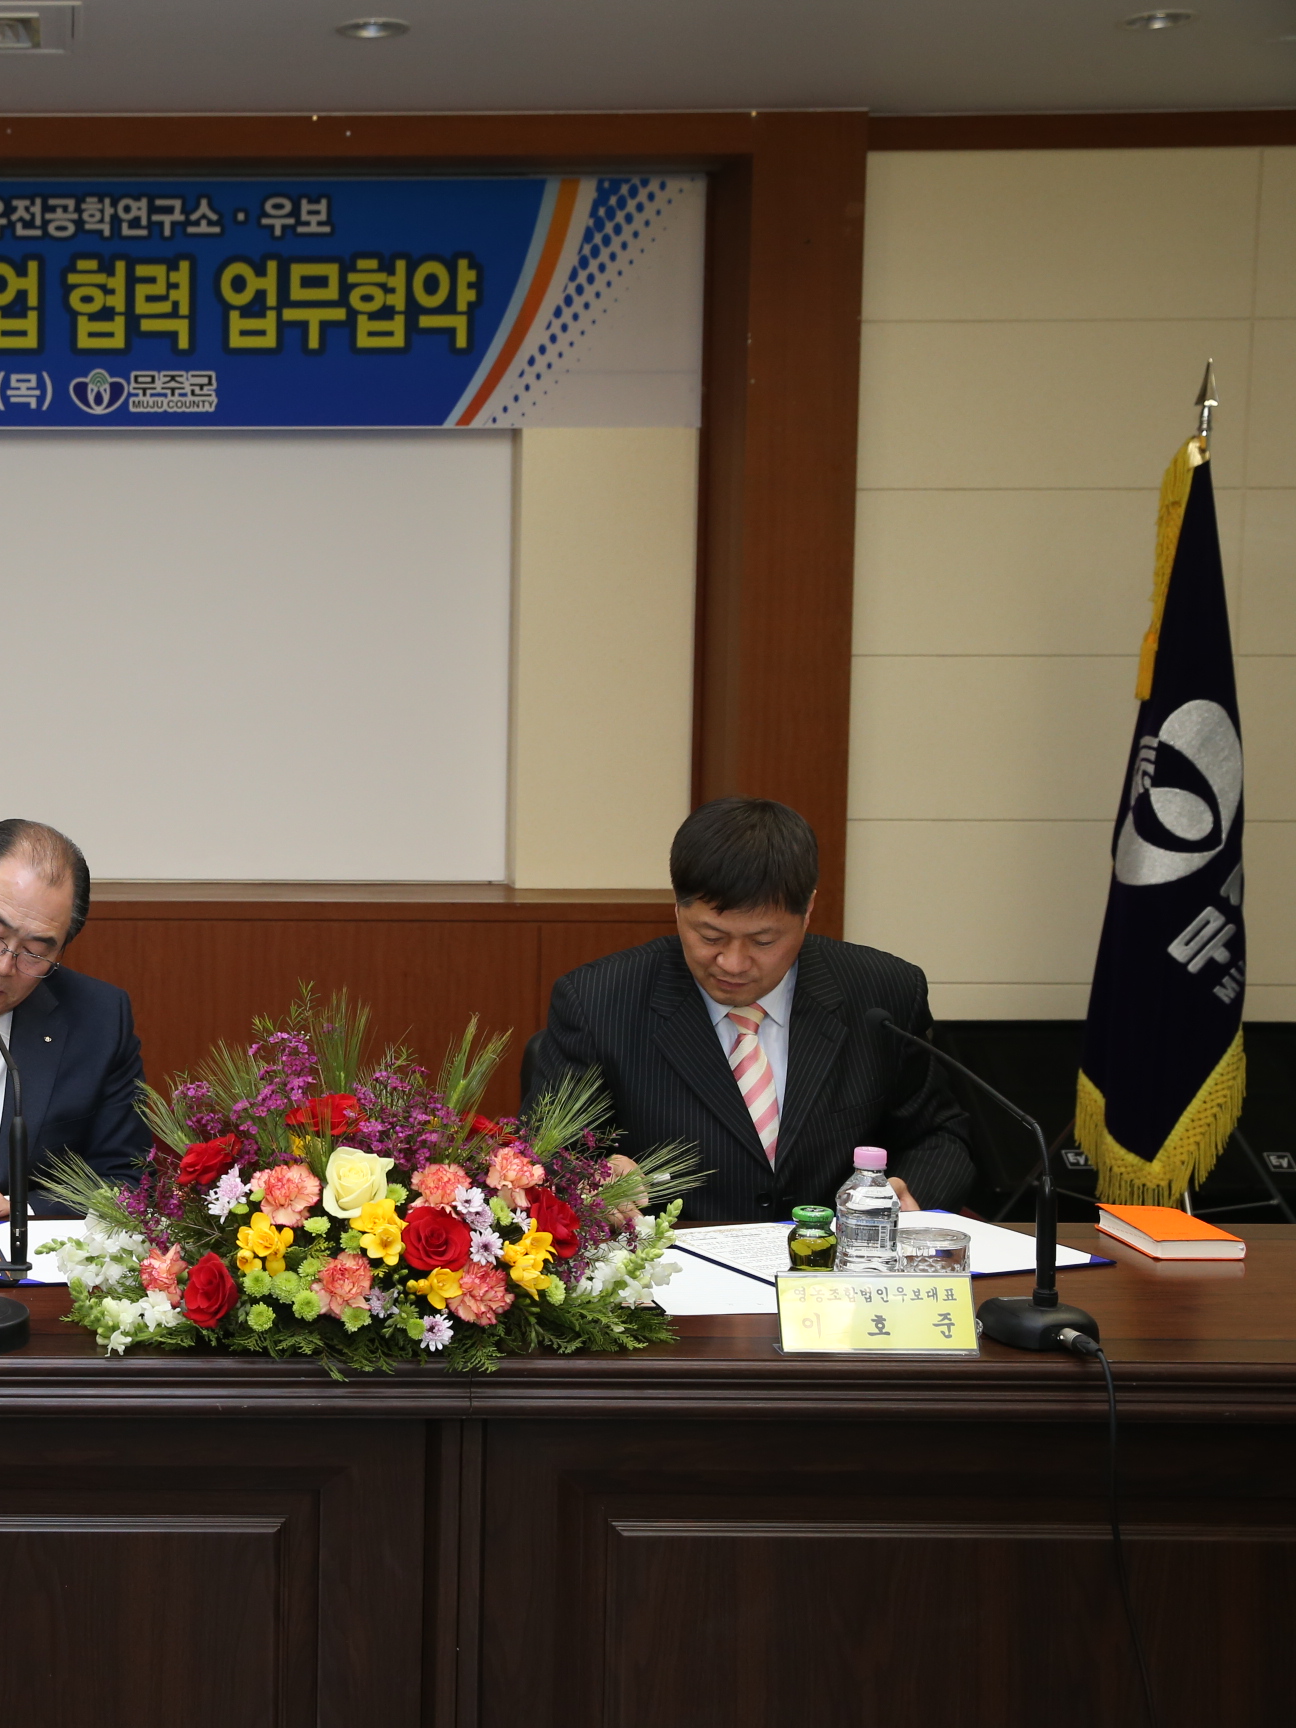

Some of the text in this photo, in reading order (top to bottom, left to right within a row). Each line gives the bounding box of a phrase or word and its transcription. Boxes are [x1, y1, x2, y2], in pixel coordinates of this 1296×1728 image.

[259, 196, 333, 237] 우보
[66, 258, 191, 350] 협력
[219, 257, 478, 350] 업무협약
[131, 373, 214, 398] 무주군
[131, 399, 216, 410] MUJU COUNTY
